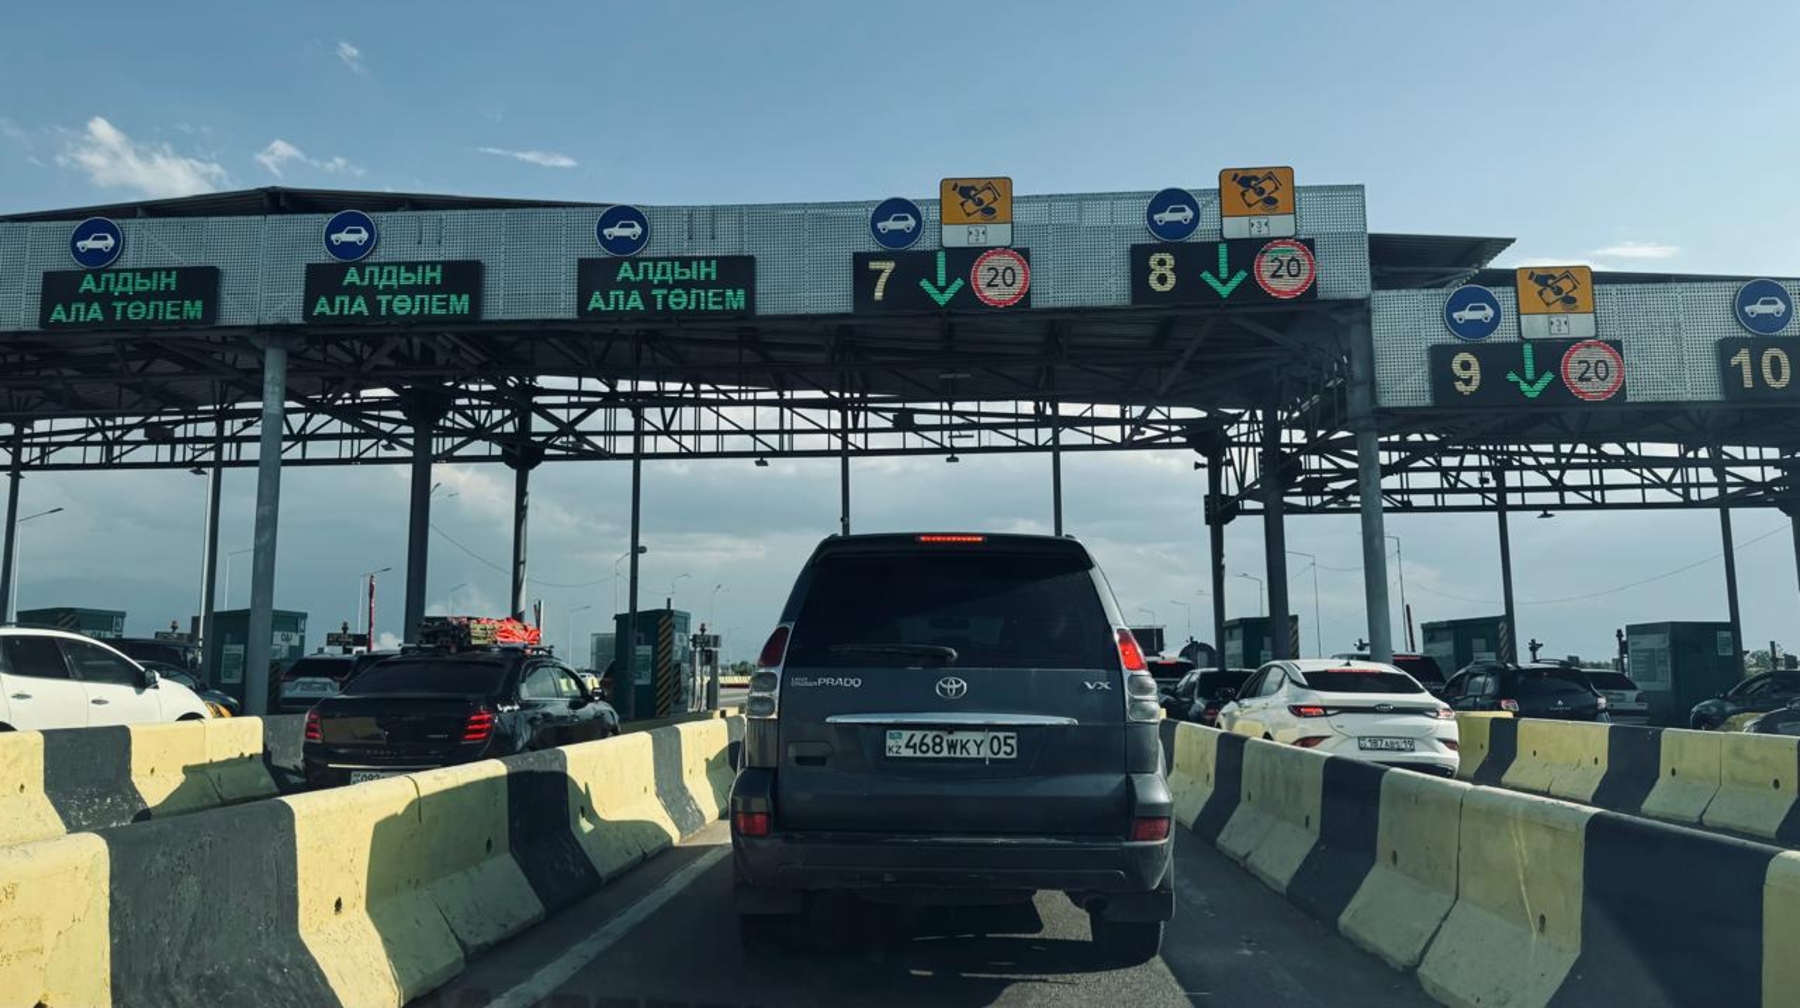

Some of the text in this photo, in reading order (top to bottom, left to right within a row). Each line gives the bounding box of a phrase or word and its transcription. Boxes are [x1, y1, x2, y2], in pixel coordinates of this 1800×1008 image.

[343, 264, 442, 290] АЛДЫН
[617, 260, 717, 283] АЛДЫН
[987, 266, 1016, 288] 20
[1149, 252, 1176, 292] 8
[1269, 257, 1302, 279] 20
[79, 271, 177, 296] АЛДЫН
[868, 260, 896, 301] 7
[314, 293, 470, 317] АЛА ТӨЛЕМ
[587, 287, 746, 311] АЛА ТӨЛЕМ
[49, 300, 203, 323] АЛА ТӨЛЕМ
[1451, 352, 1482, 396] 9
[1577, 360, 1610, 382] 20
[1730, 348, 1790, 389] 10
[818, 677, 862, 688] PRADO
[1083, 681, 1112, 691] VX
[888, 745, 902, 755] KZ
